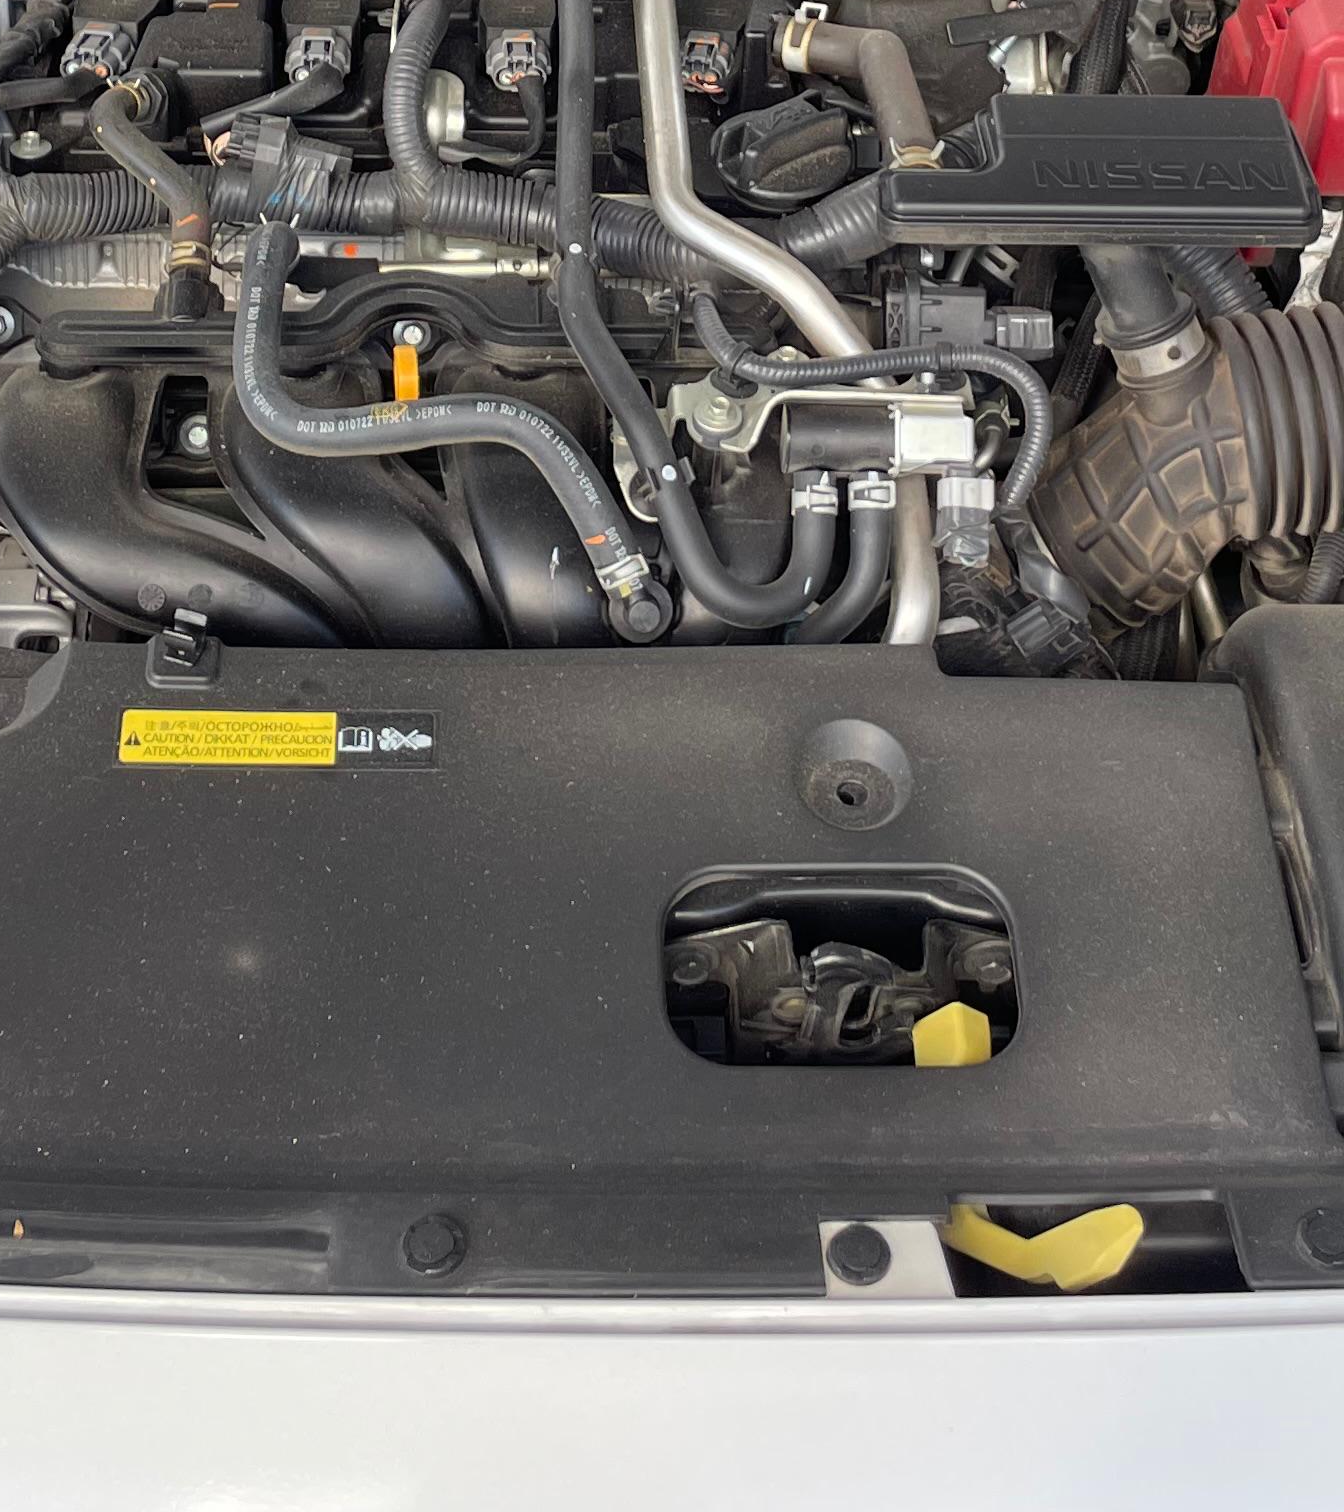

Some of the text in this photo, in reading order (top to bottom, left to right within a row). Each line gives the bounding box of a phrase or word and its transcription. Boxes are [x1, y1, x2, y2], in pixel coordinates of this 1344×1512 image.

[1032, 159, 1289, 191] NISSAN
[297, 419, 316, 433] DOT
[337, 415, 373, 432] 010722
[476, 401, 497, 413] DOT
[519, 409, 555, 440] 010722
[605, 526, 622, 546] DOT
[143, 733, 195, 744] CAUTION
